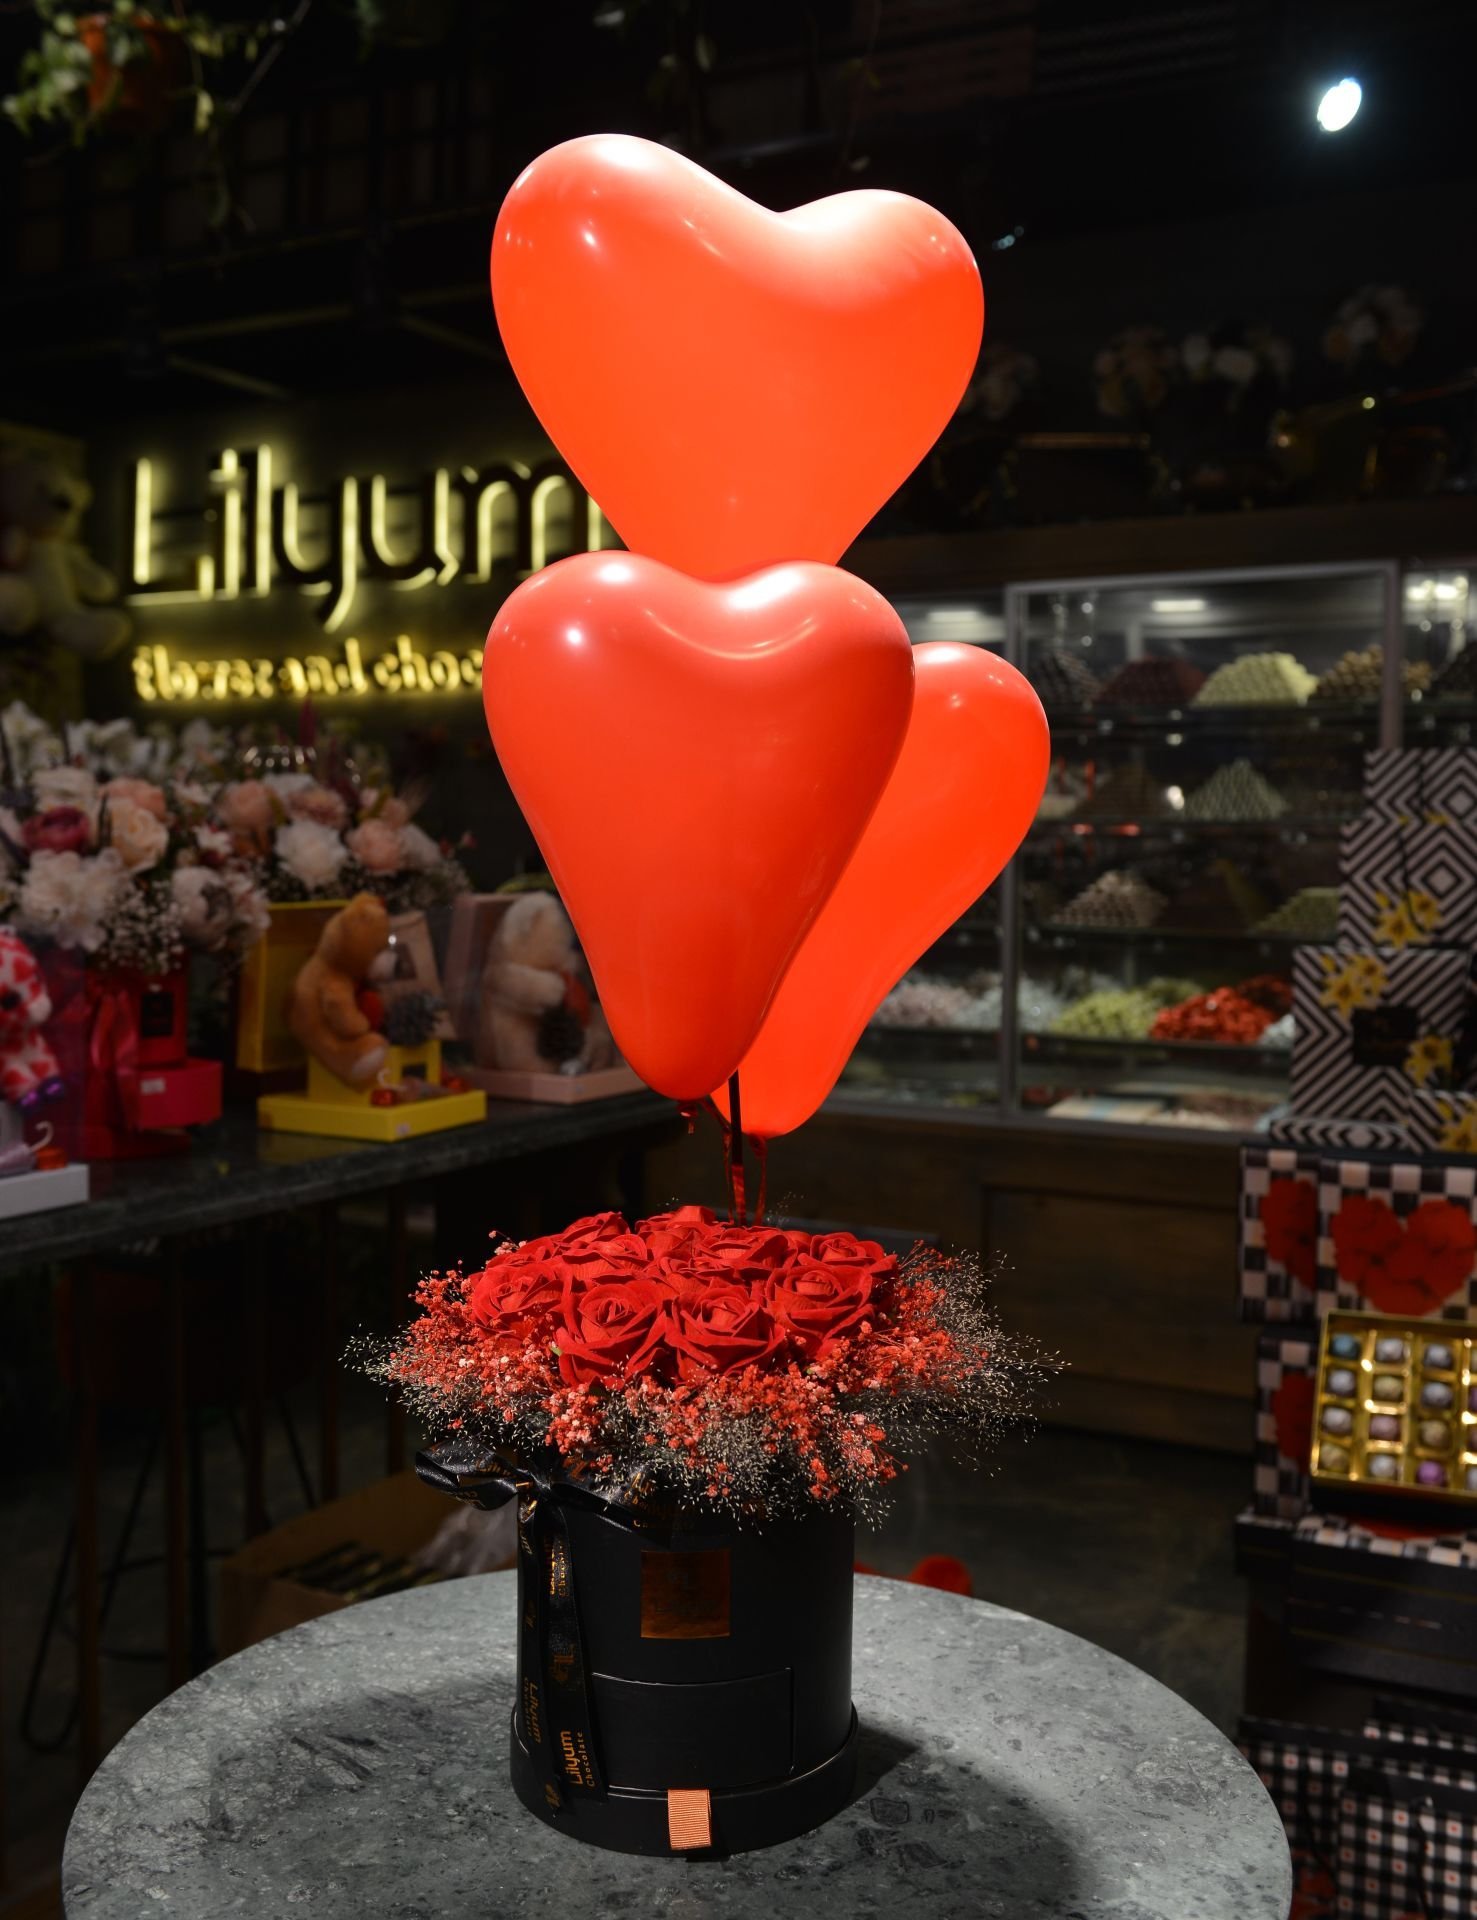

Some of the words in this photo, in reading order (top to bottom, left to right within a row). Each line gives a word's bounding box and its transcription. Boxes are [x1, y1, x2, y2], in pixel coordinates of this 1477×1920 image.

[126, 442, 606, 634] Lilyum
[278, 636, 368, 696] and
[559, 1728, 584, 1786] Lilyum
[576, 1731, 596, 1788] Chocolate
